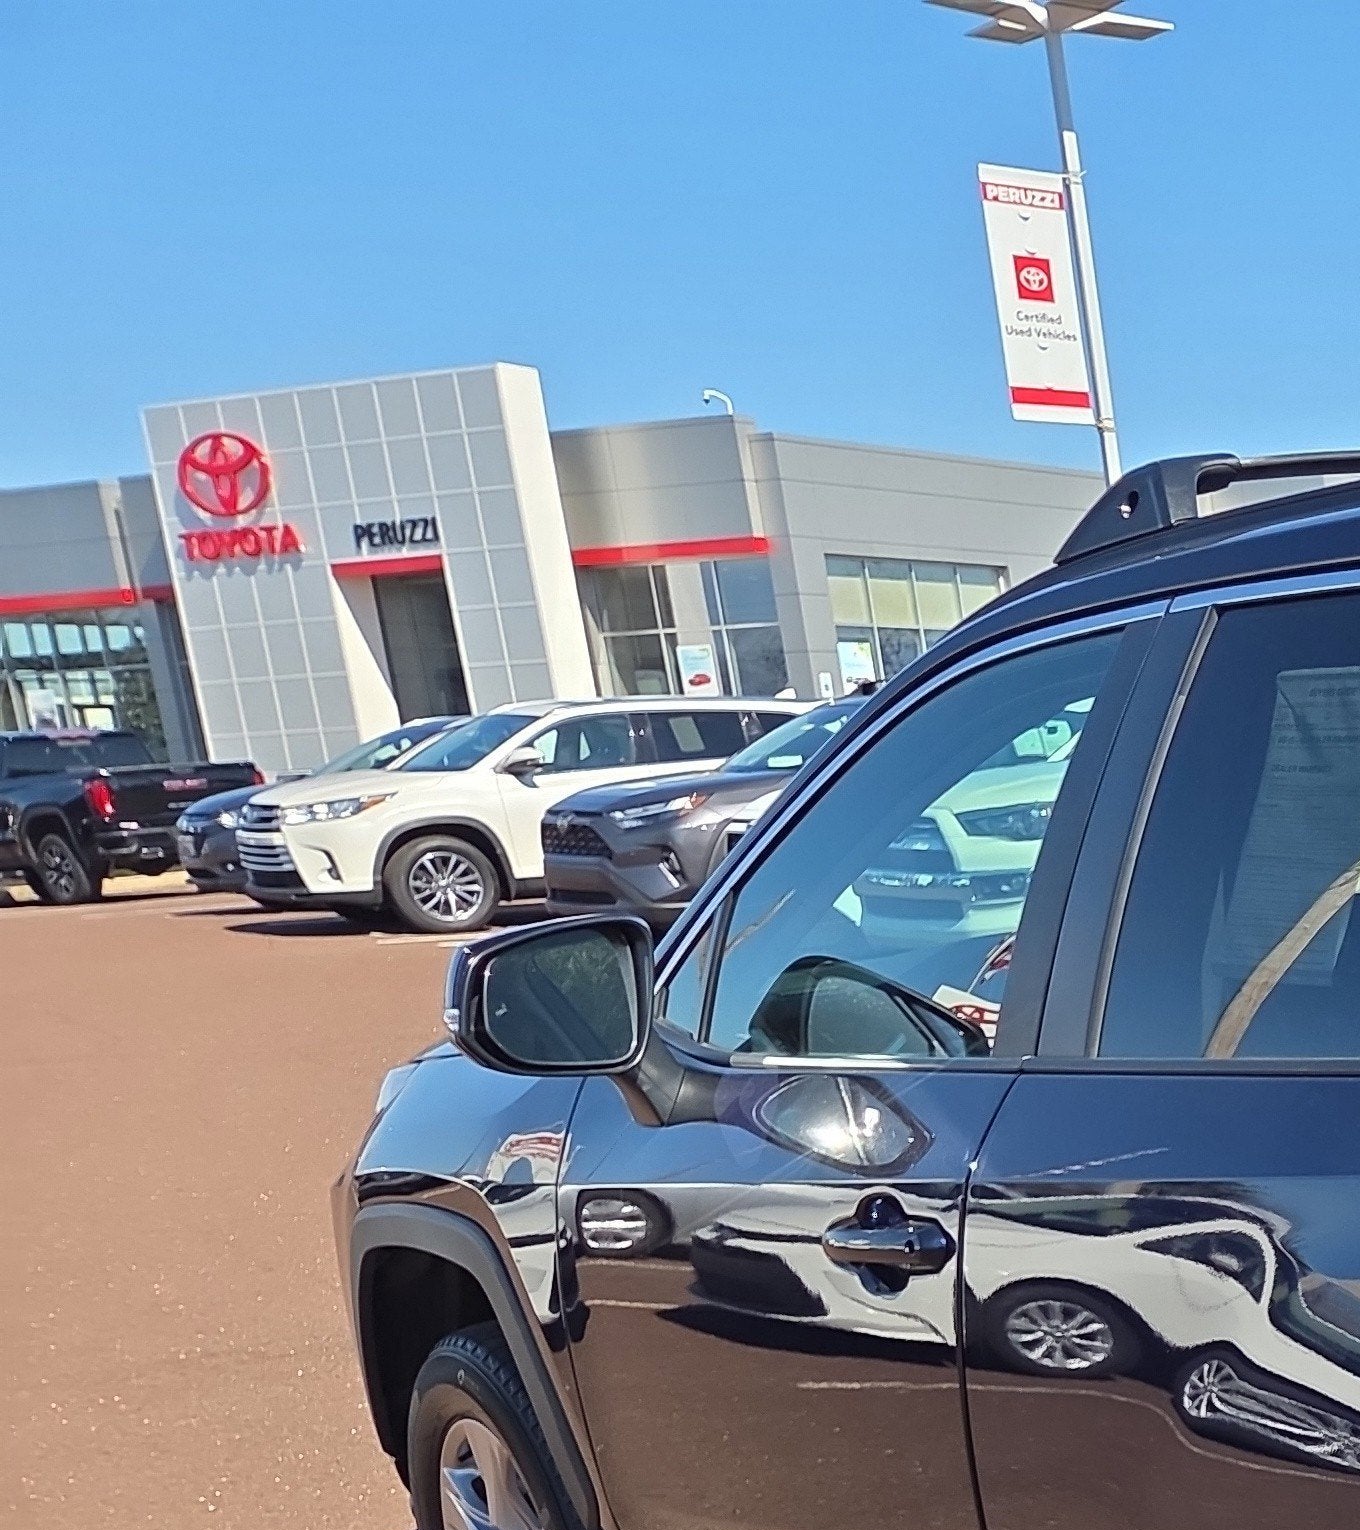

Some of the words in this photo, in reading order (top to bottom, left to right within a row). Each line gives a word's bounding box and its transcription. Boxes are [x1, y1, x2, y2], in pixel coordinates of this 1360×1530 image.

[984, 183, 1061, 209] PERUZZI
[1016, 310, 1062, 325] Certified
[1005, 325, 1032, 337] Used
[1035, 328, 1077, 342] Vehicles
[178, 524, 302, 560] TOYOTA
[353, 516, 440, 548] PERUZZI
